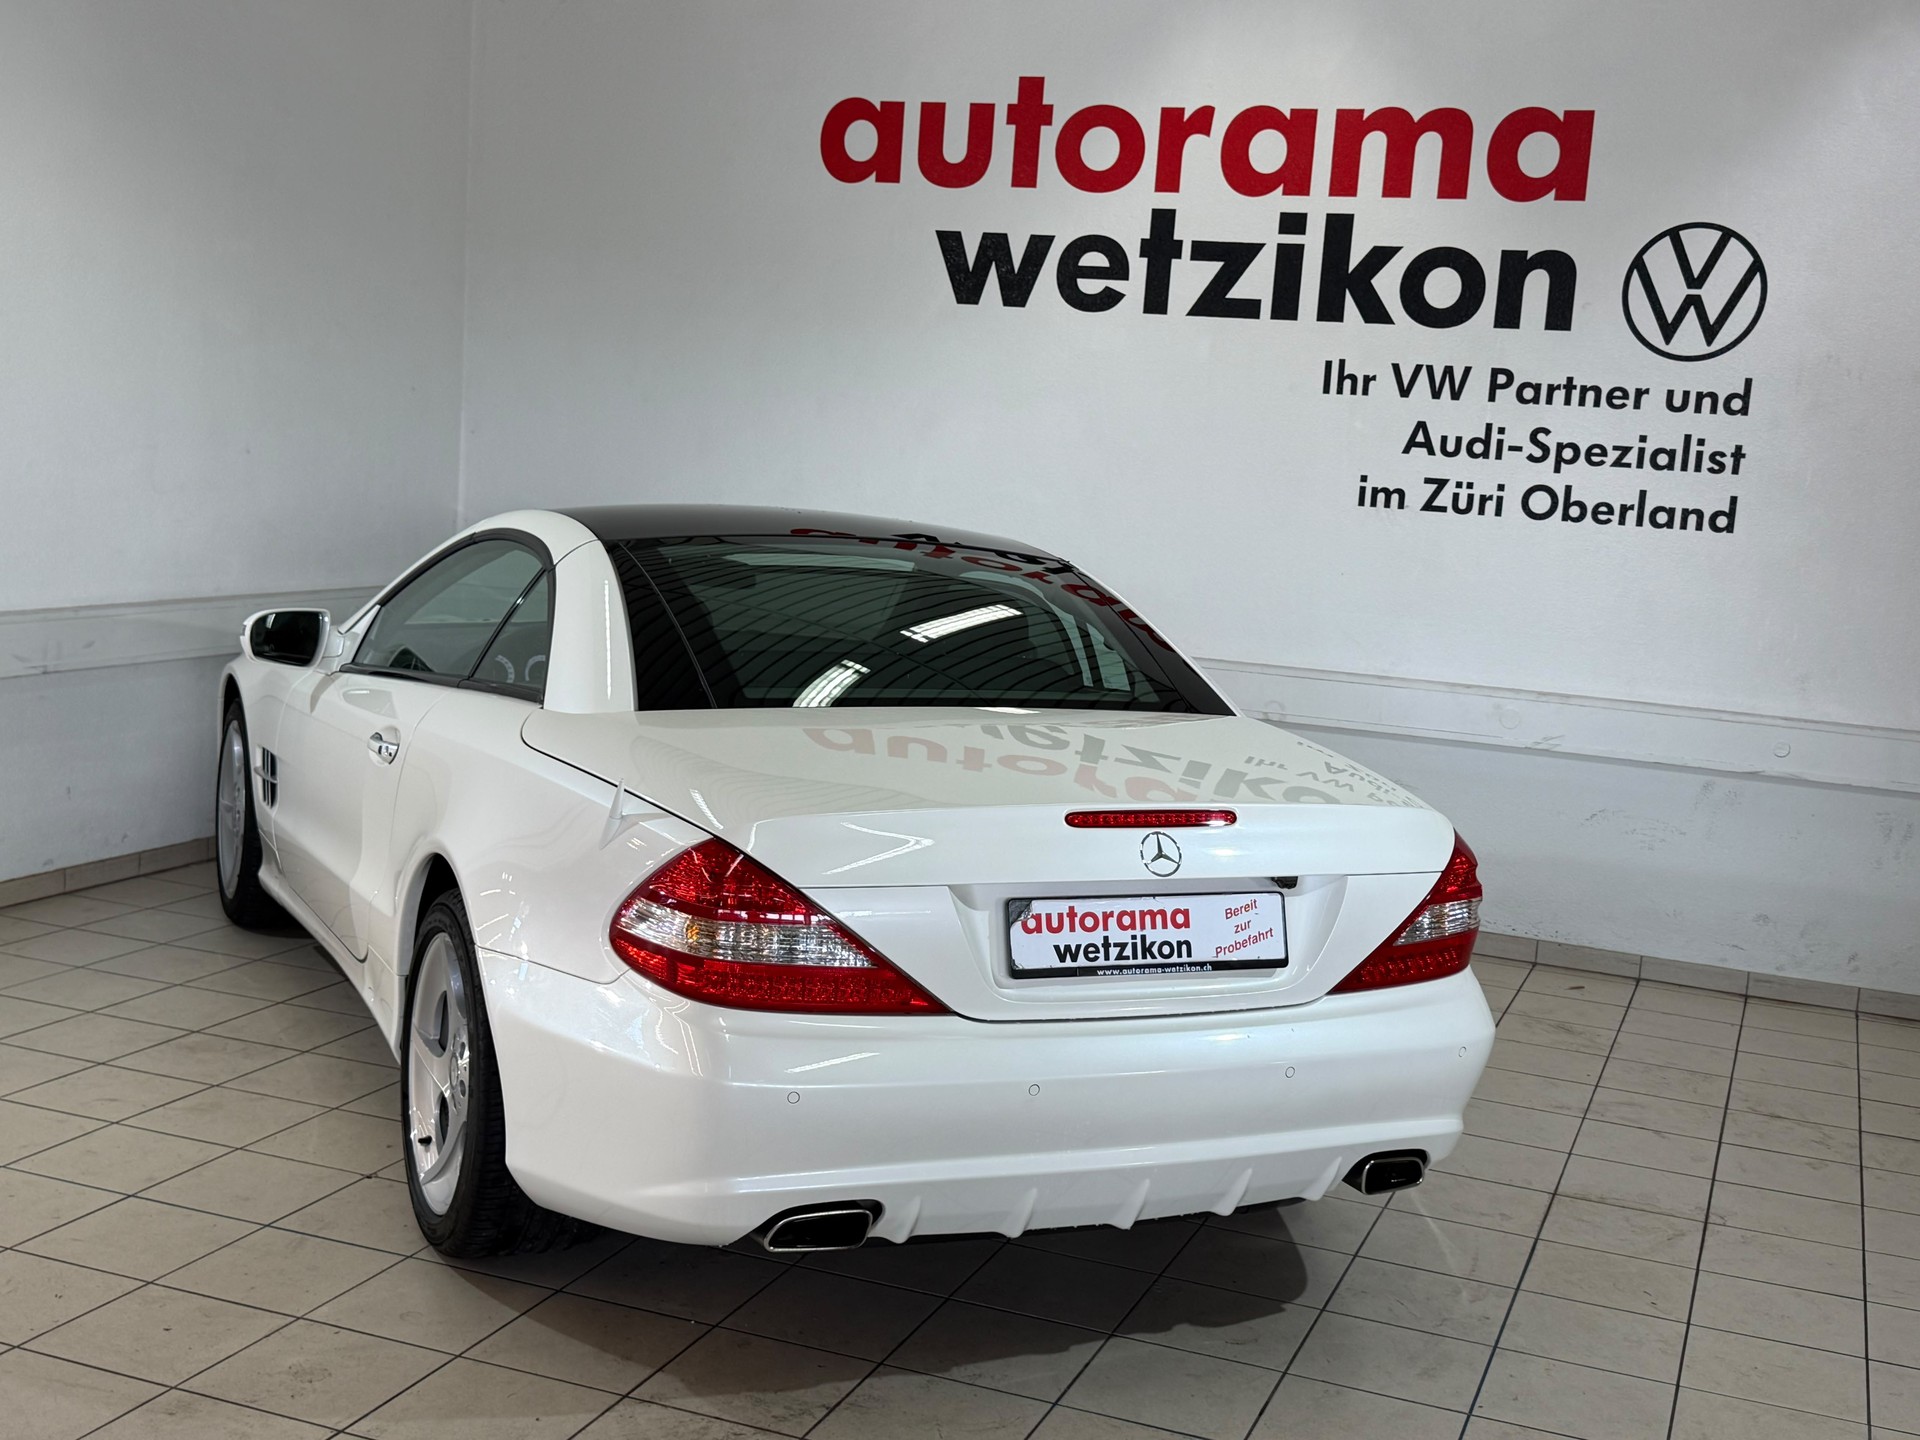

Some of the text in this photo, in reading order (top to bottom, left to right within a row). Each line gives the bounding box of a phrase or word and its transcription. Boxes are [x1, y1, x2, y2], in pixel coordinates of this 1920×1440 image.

[820, 76, 1596, 203] autorama
[935, 209, 1578, 332] wetzikon
[1322, 359, 1754, 417] Ihr VW Partner und
[1401, 420, 1748, 476] Audi-Spezialist
[1356, 474, 1740, 535] im Züri Oberland
[1020, 905, 1192, 935] autorama
[1224, 898, 1258, 920] Bereit
[1234, 919, 1252, 934] zur
[1052, 934, 1193, 964] wetzikon
[1214, 927, 1274, 958] Probefahrt
[1096, 963, 1213, 976] www.autorama-wetzikon.ch
